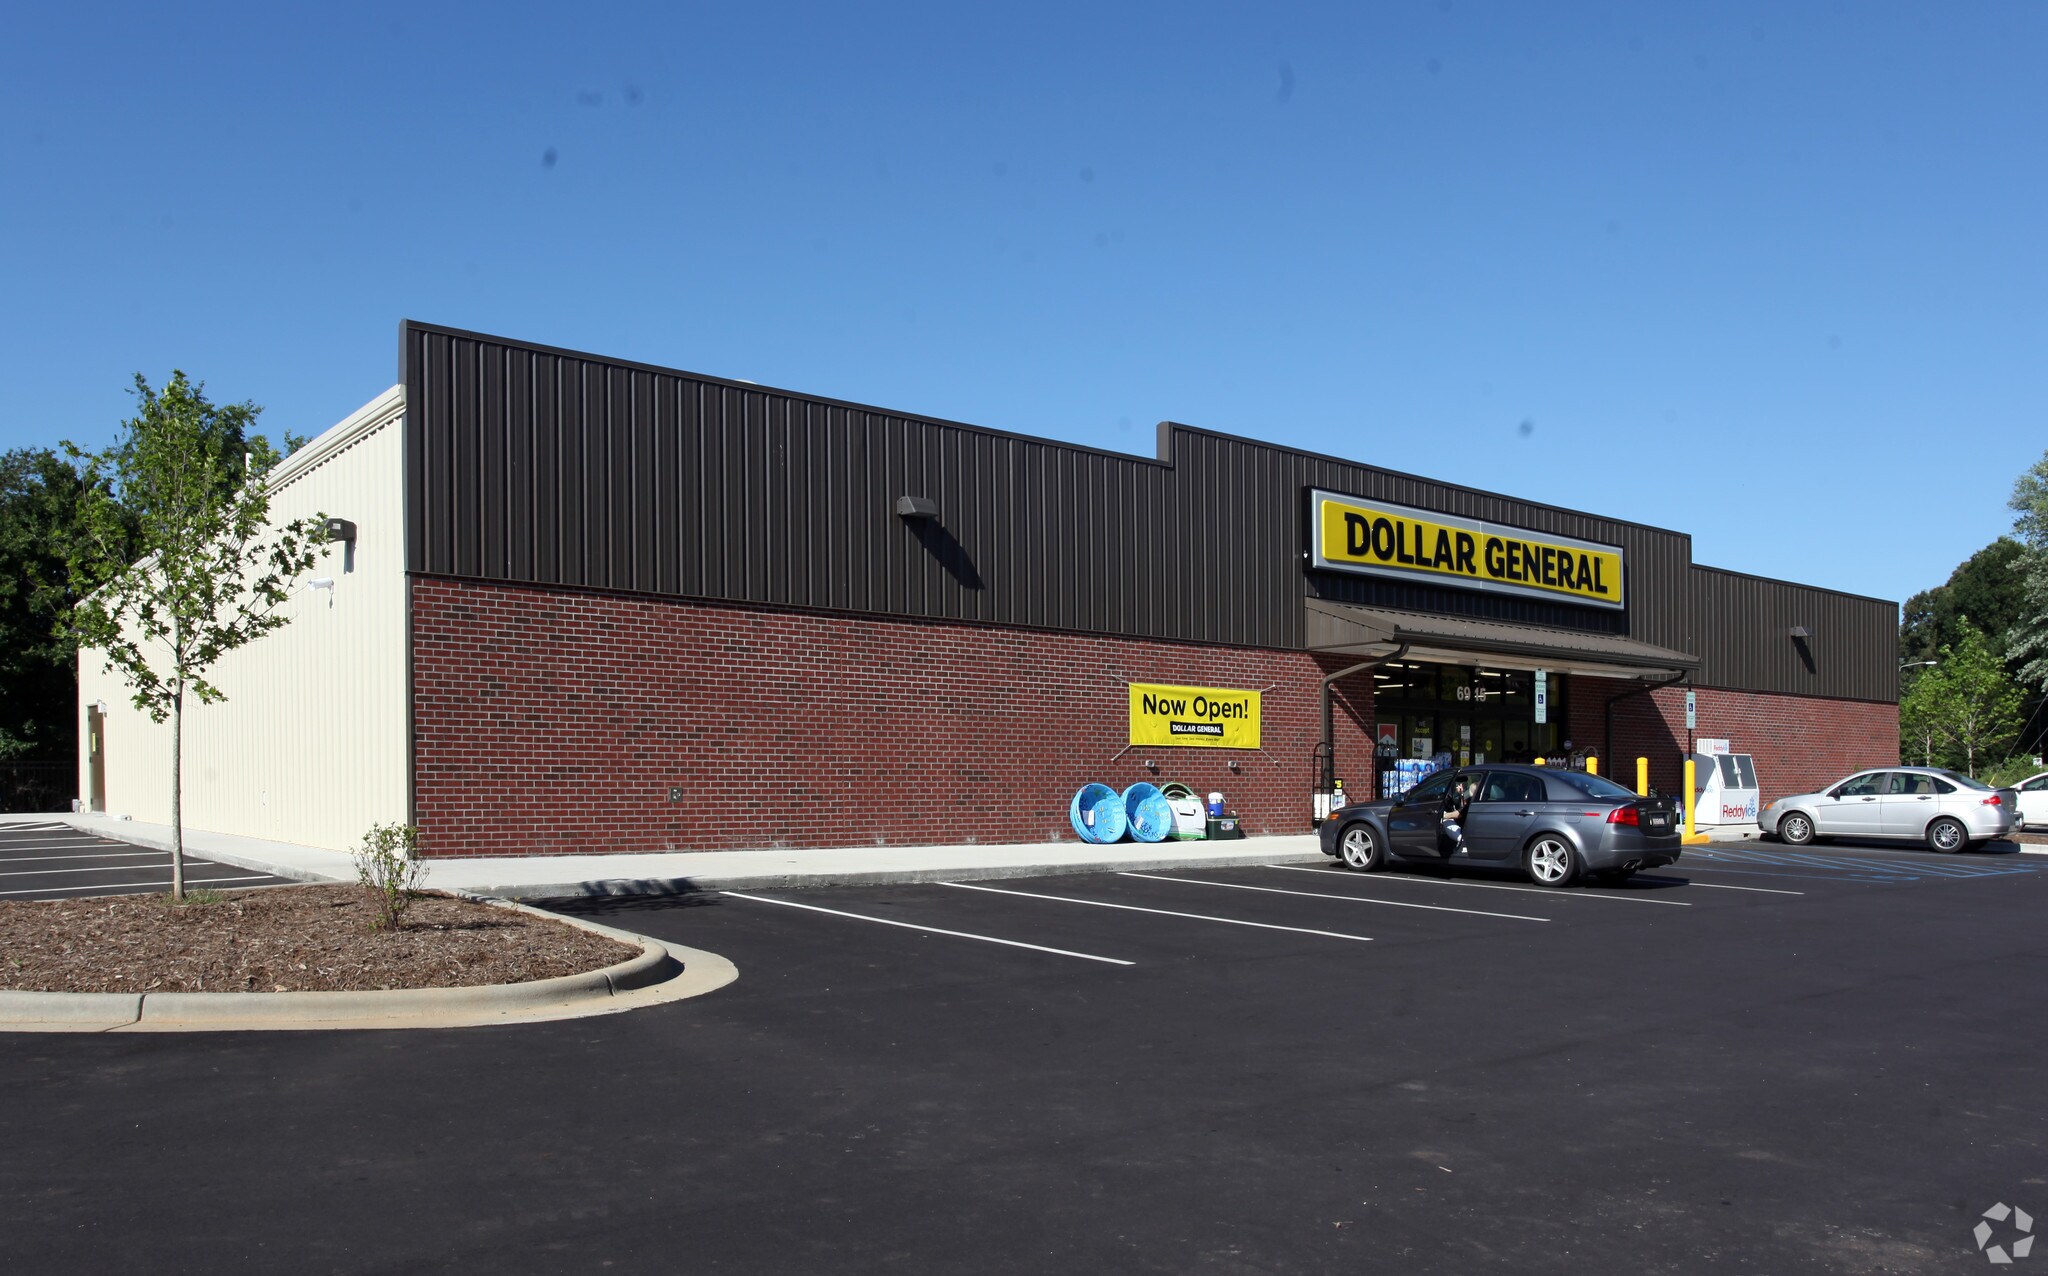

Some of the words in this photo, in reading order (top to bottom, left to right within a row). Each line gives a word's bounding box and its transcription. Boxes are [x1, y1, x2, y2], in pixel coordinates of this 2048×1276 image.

[1344, 511, 1477, 575] DOLLAR
[1485, 536, 1608, 595] GENERAL
[1142, 693, 1187, 716] Now
[1193, 695, 1249, 721] Open!
[1172, 724, 1196, 733] DOLLAR
[1197, 725, 1222, 734] GENERAL
[1414, 727, 1430, 735] Accept
